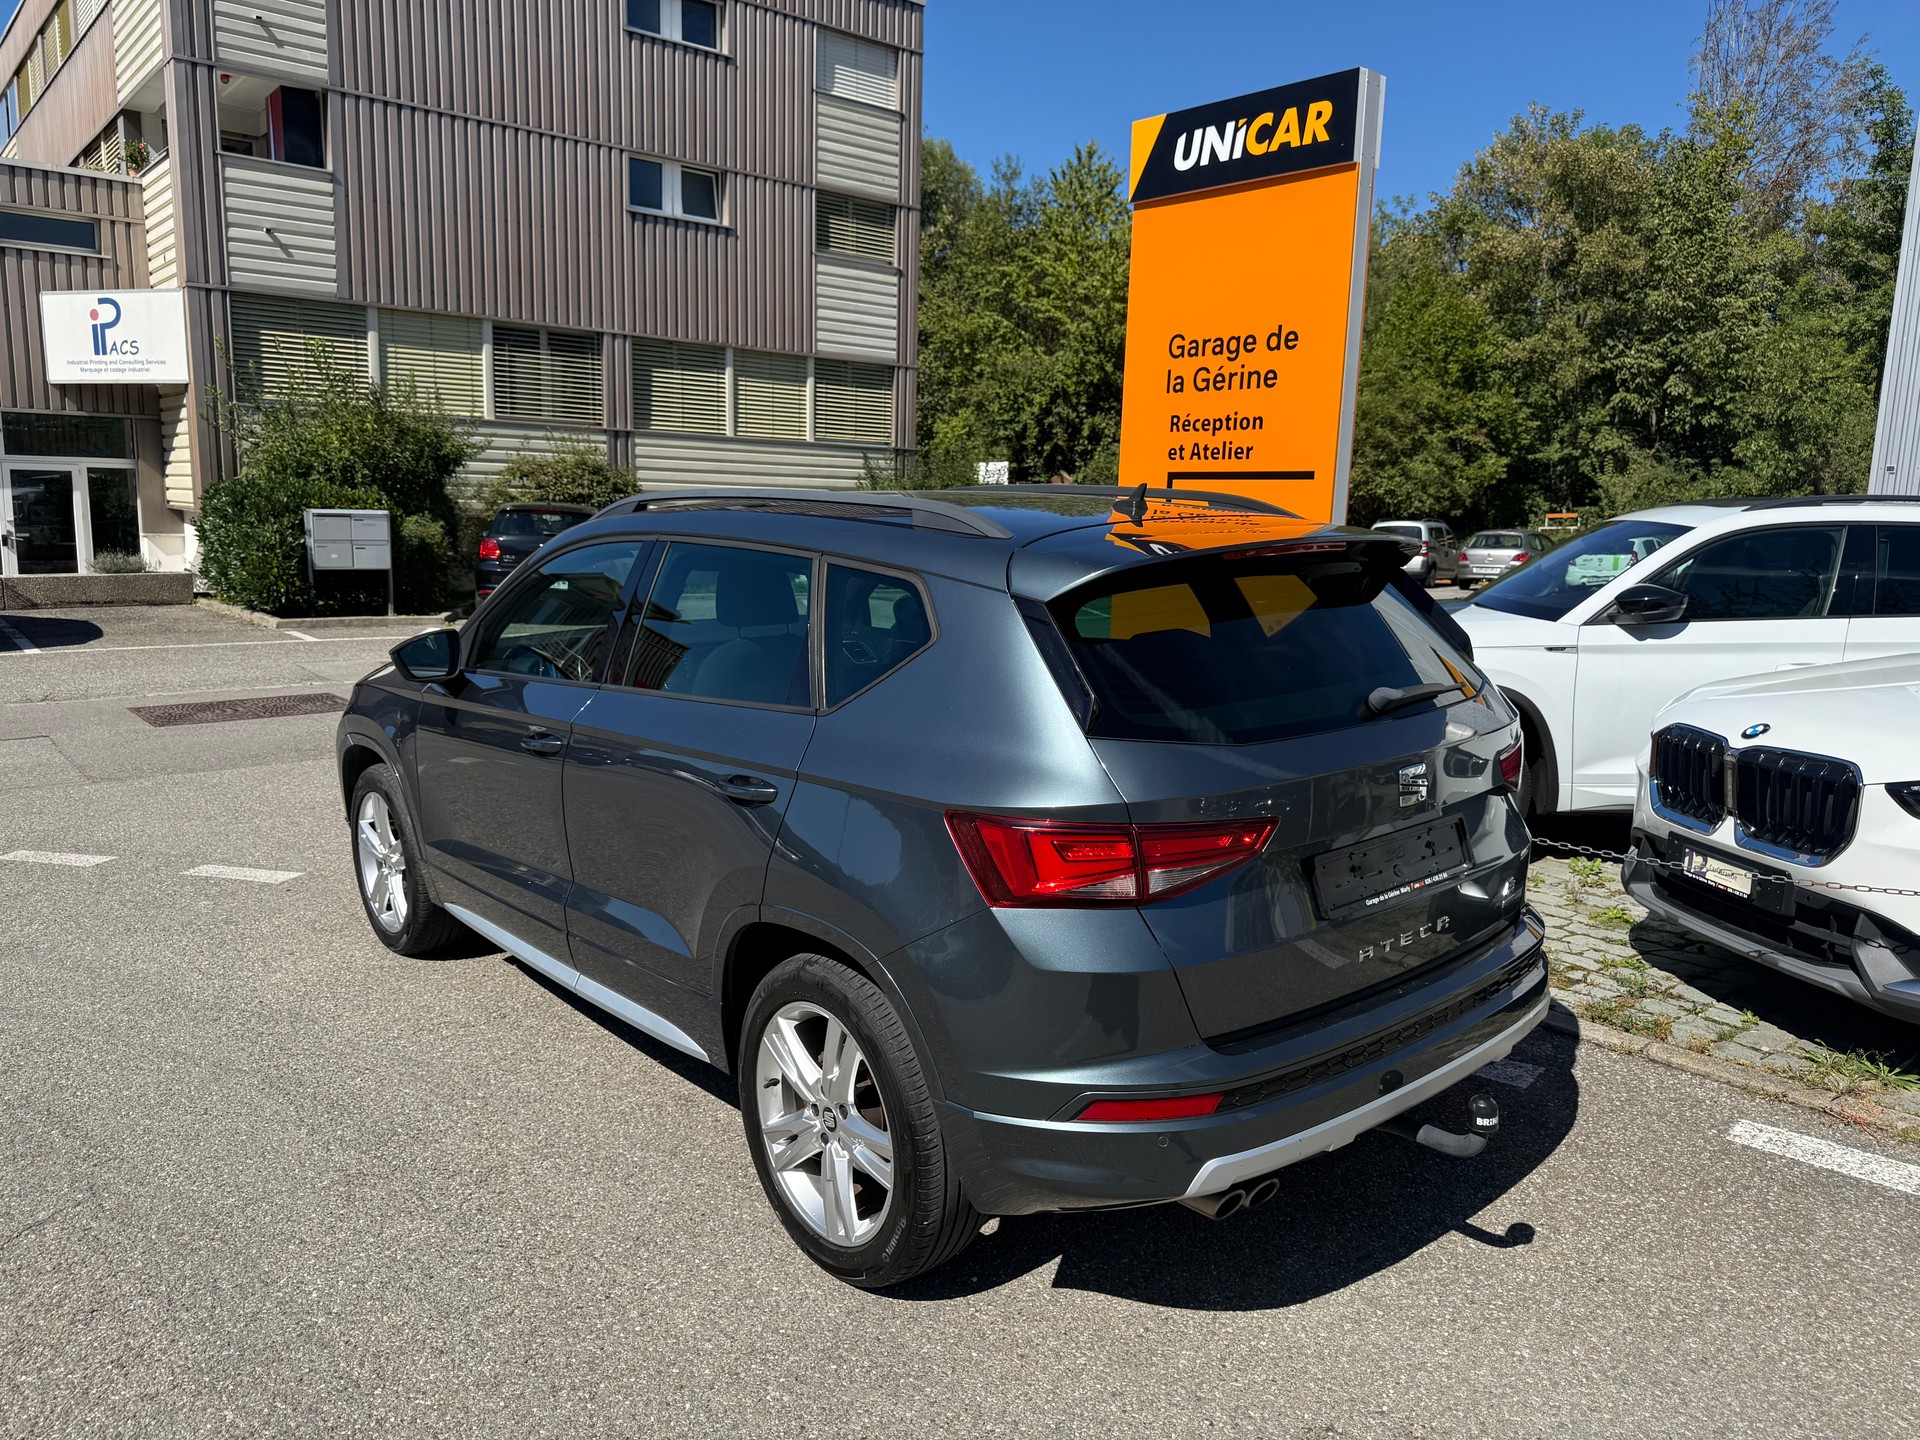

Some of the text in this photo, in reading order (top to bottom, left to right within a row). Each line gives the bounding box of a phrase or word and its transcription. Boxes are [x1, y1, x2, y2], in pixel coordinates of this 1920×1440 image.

[1168, 324, 1299, 362] Garage de
[119, 358, 144, 366] Consulting
[1166, 364, 1278, 394] la Gérine
[1169, 411, 1264, 437] Réception
[1168, 440, 1254, 461] et Atelier
[1358, 915, 1451, 963] ATECA
